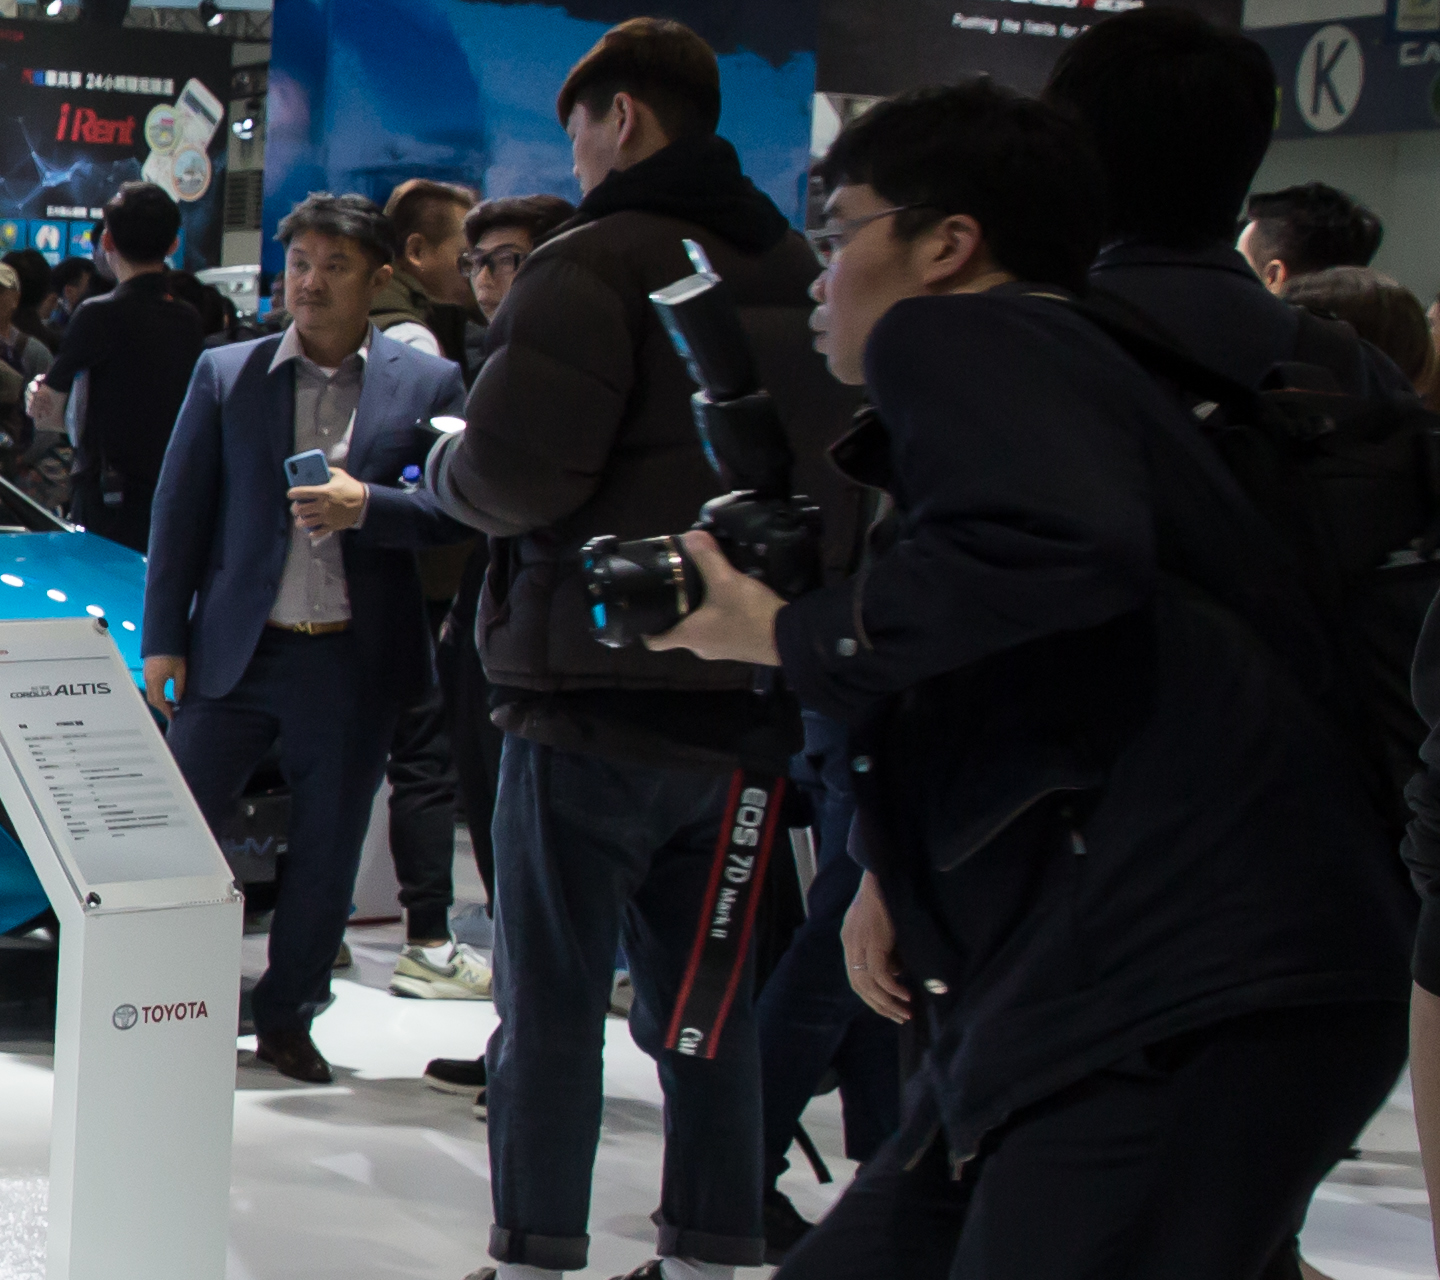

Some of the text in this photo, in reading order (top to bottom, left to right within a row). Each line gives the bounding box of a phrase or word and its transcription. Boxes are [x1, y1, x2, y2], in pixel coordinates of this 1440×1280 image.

[1310, 38, 1349, 117] K
[54, 682, 112, 697] ALTIS
[723, 852, 755, 884] 7D
[711, 886, 739, 926] Mark
[141, 1000, 208, 1024] TOYOTA
